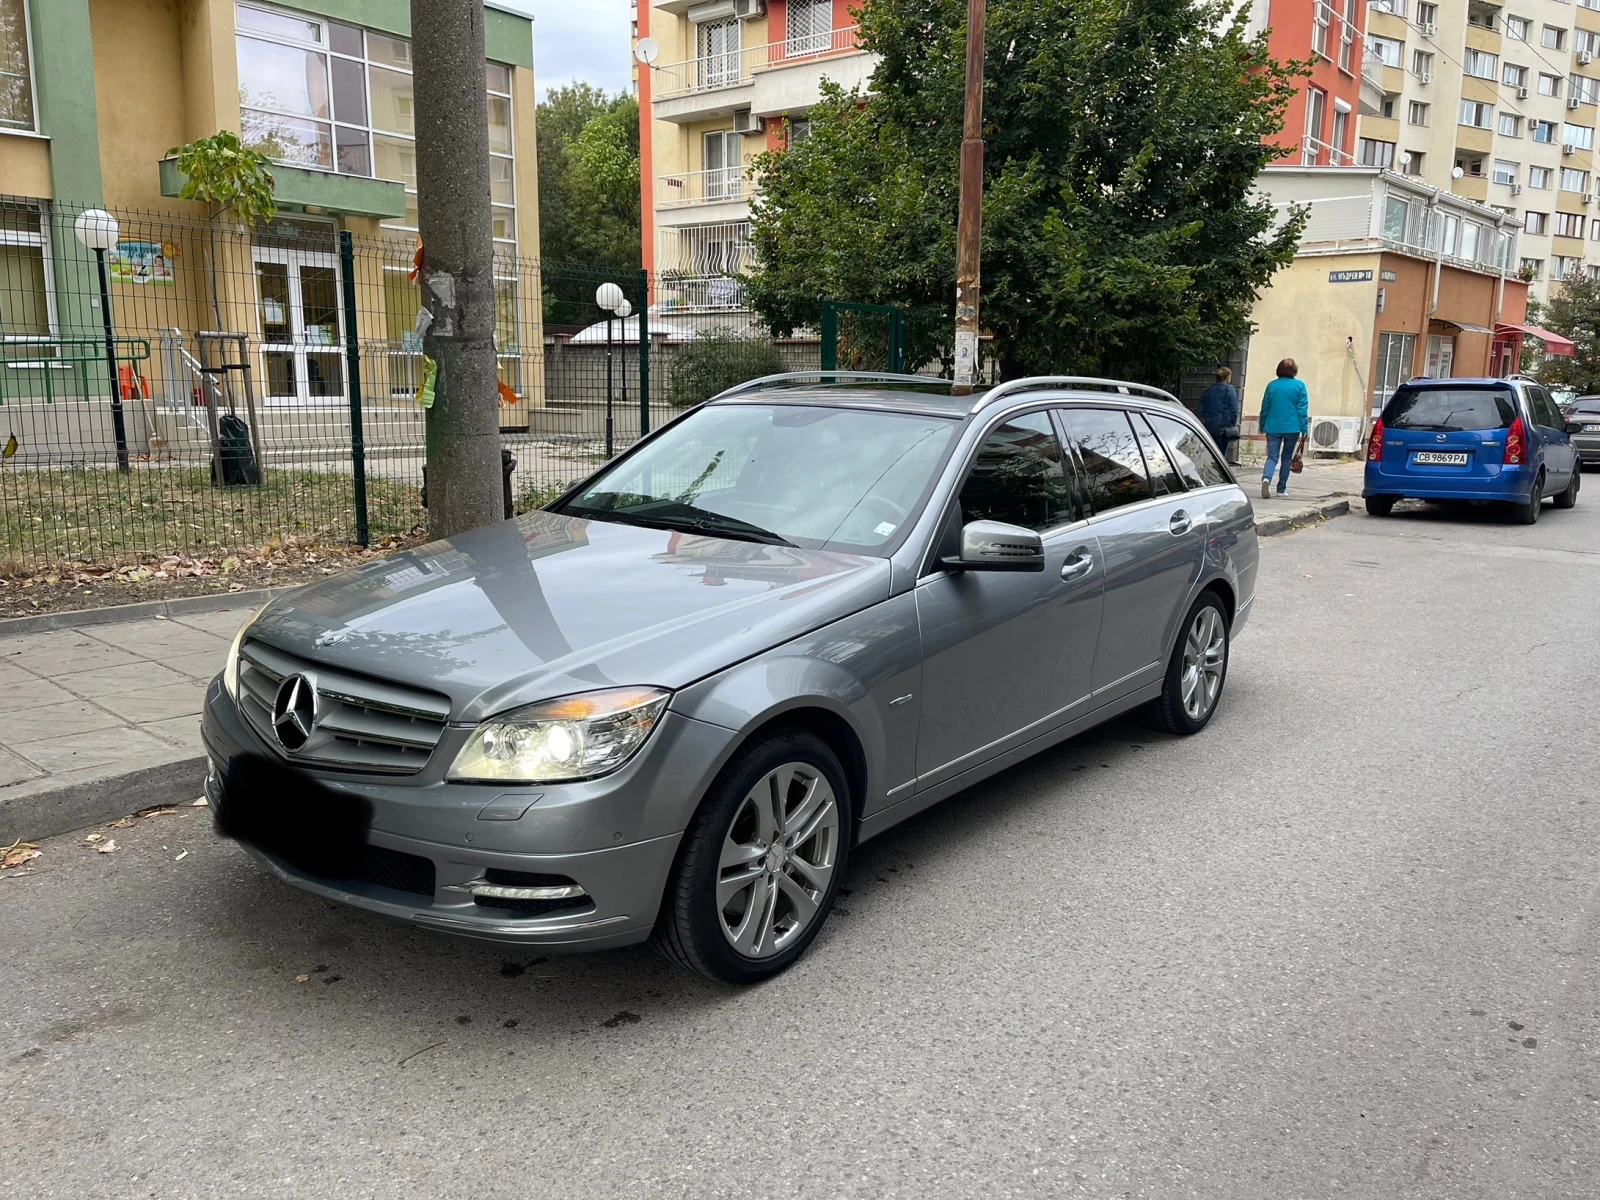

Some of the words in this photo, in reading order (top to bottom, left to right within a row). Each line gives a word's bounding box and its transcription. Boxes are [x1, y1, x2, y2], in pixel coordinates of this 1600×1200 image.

[1418, 453, 1431, 462] CB
[1431, 454, 1453, 463] 9869
[1453, 454, 1465, 463] PA
